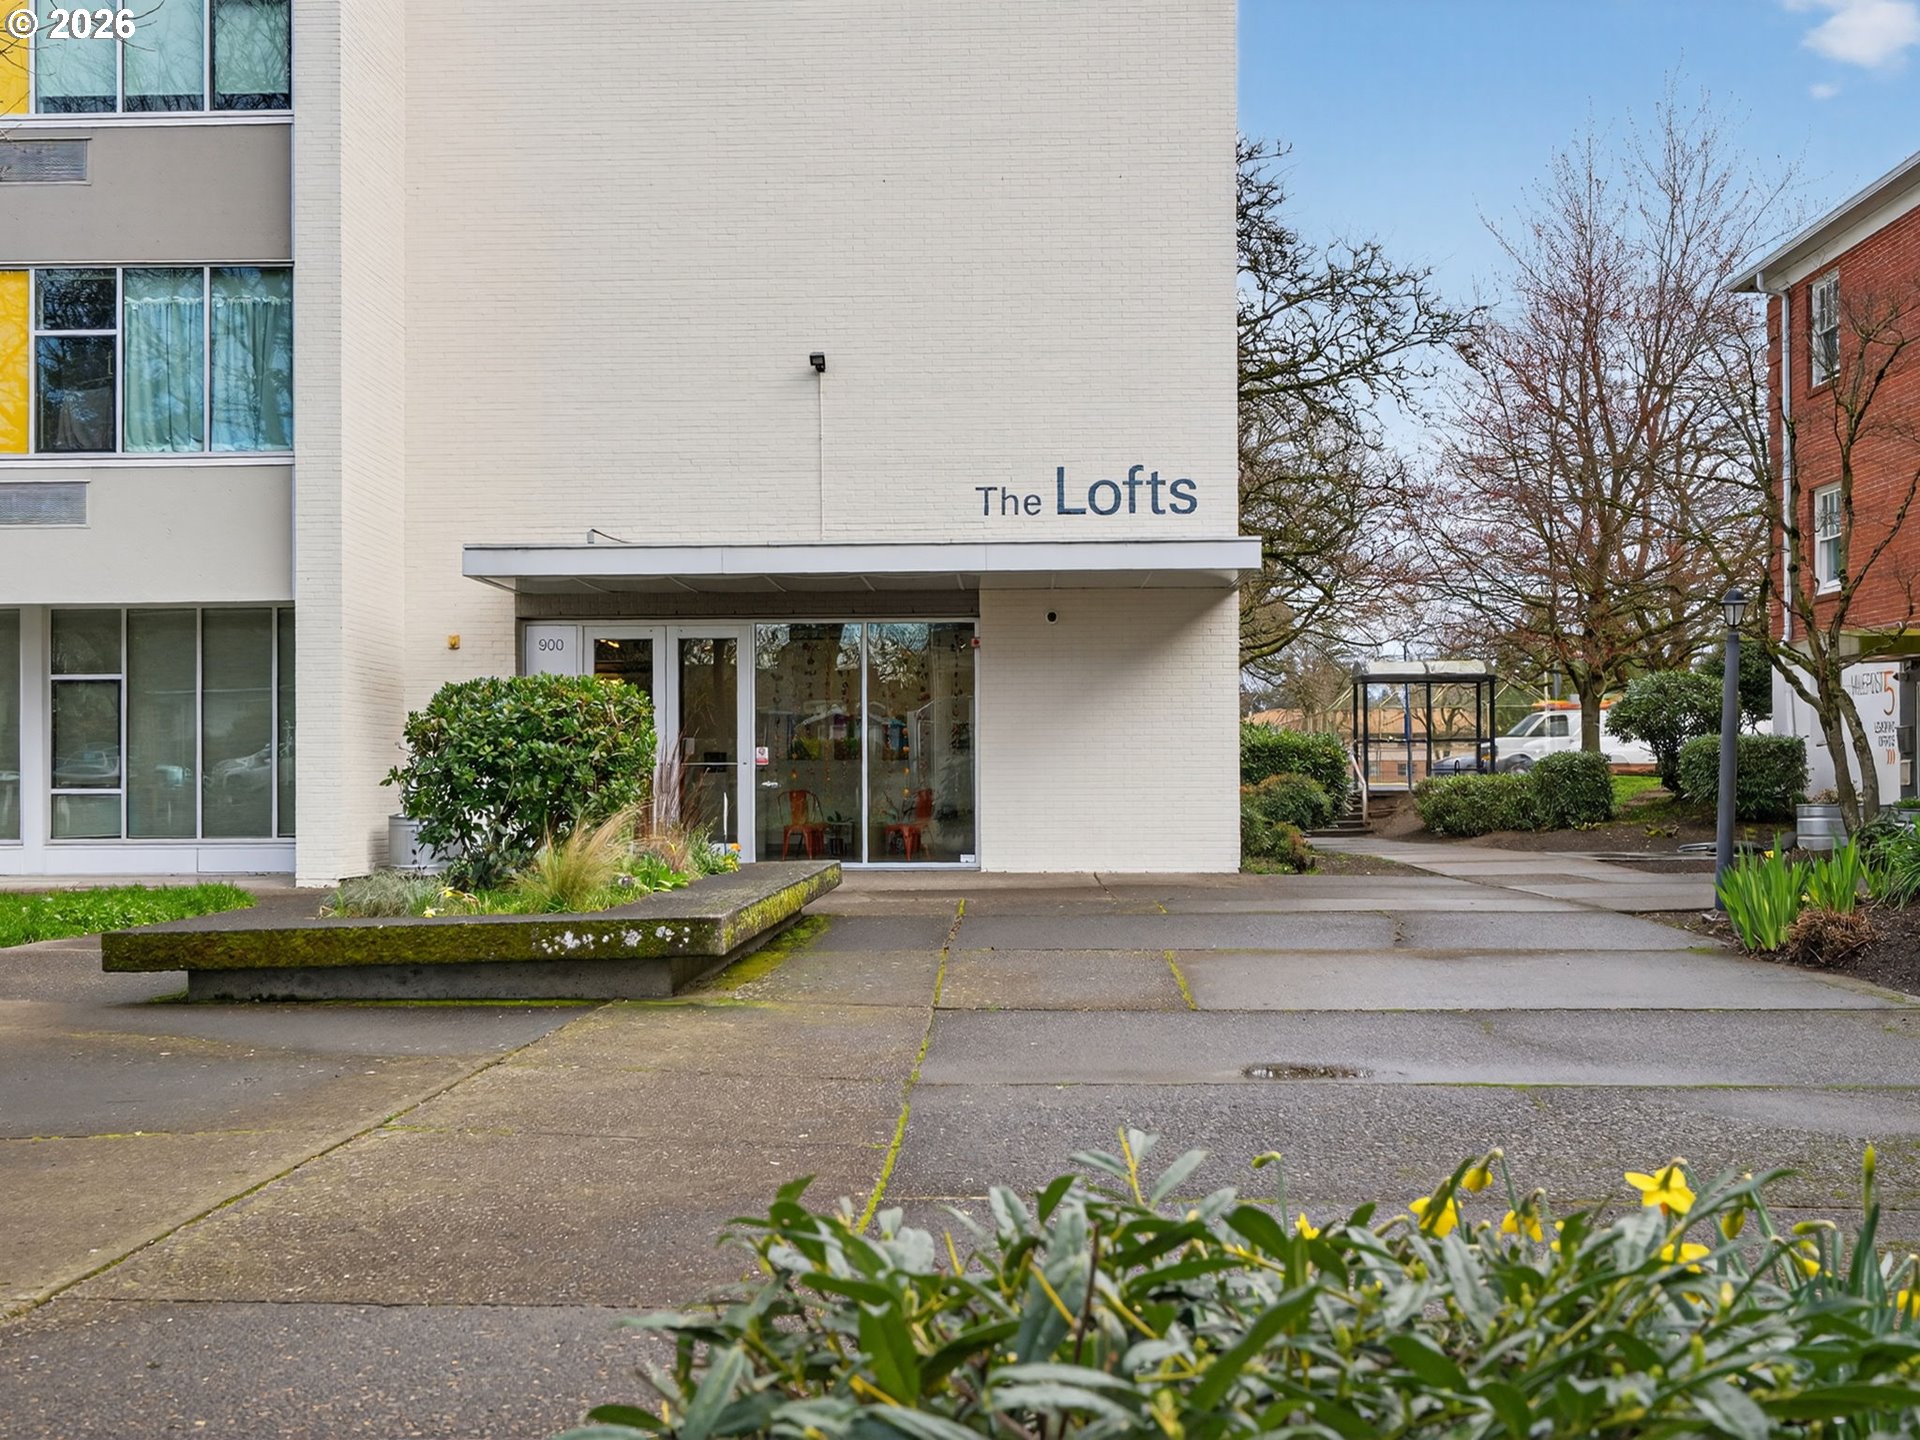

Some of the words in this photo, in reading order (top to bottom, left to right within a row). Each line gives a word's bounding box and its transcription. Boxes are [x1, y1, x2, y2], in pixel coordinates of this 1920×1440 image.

[975, 486, 1042, 516] The
[1056, 464, 1198, 516] Lofts
[538, 638, 565, 651] 900
